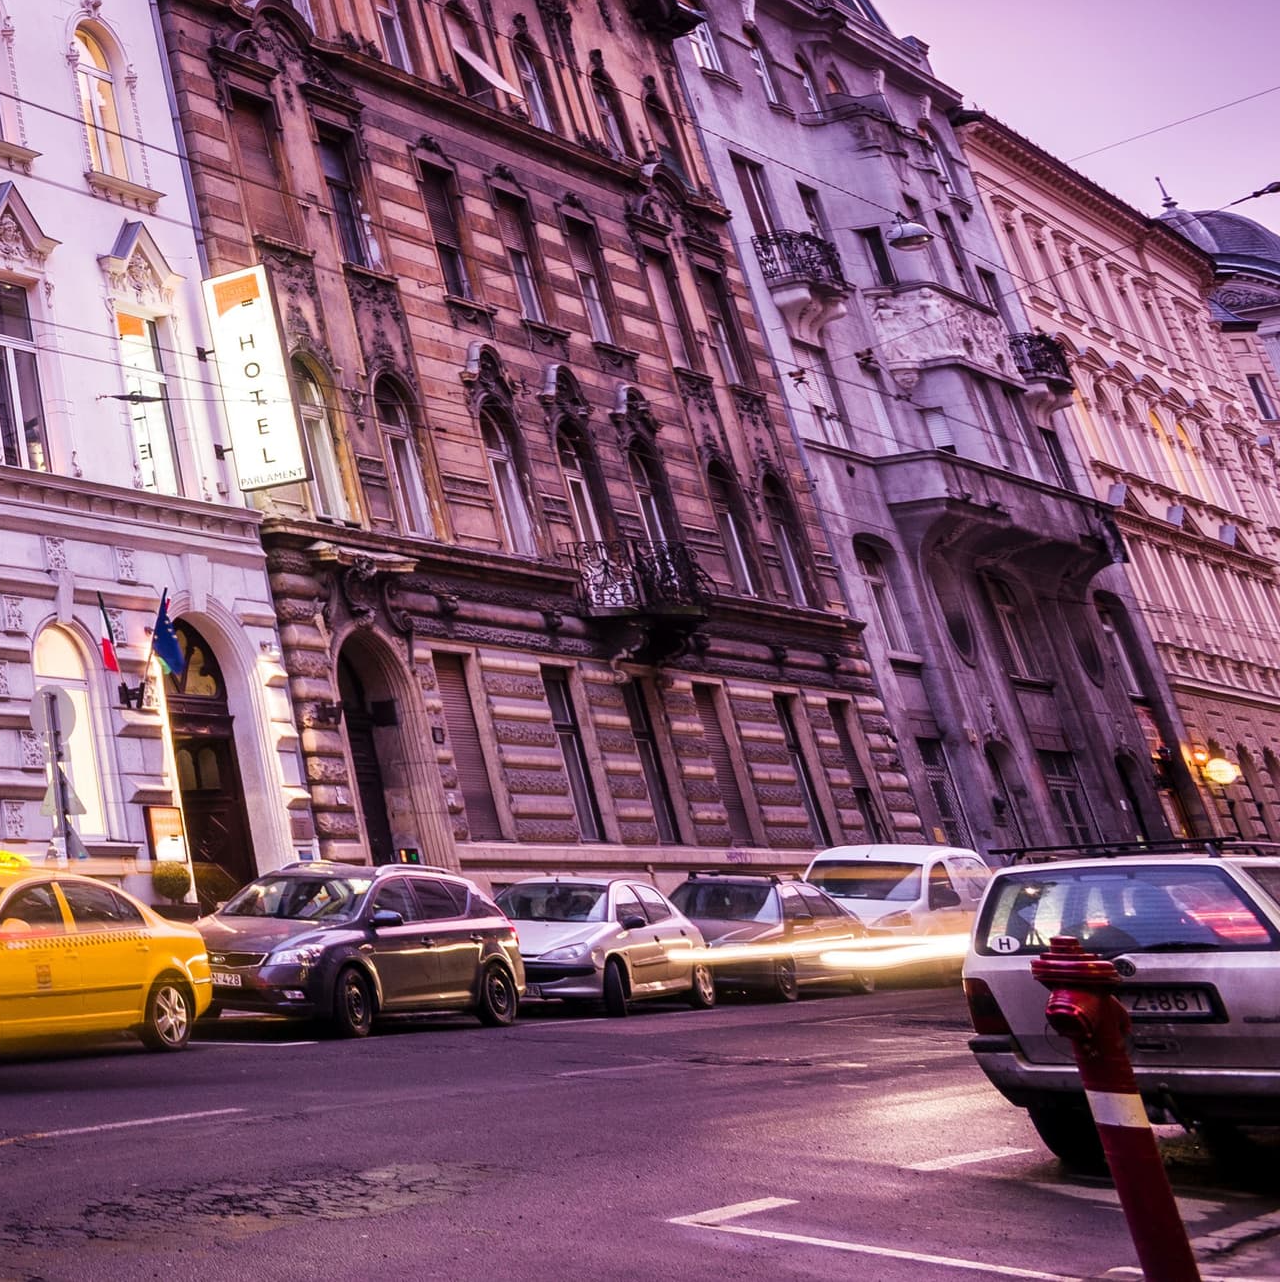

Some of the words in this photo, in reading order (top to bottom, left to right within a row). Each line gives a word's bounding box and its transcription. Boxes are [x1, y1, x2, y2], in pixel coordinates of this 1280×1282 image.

[239, 333, 276, 464] HOTEL
[240, 466, 304, 487] PARLAMENT
[999, 939, 1011, 950] H
[212, 974, 240, 985] N-428
[1132, 989, 1204, 1011] Z-861
